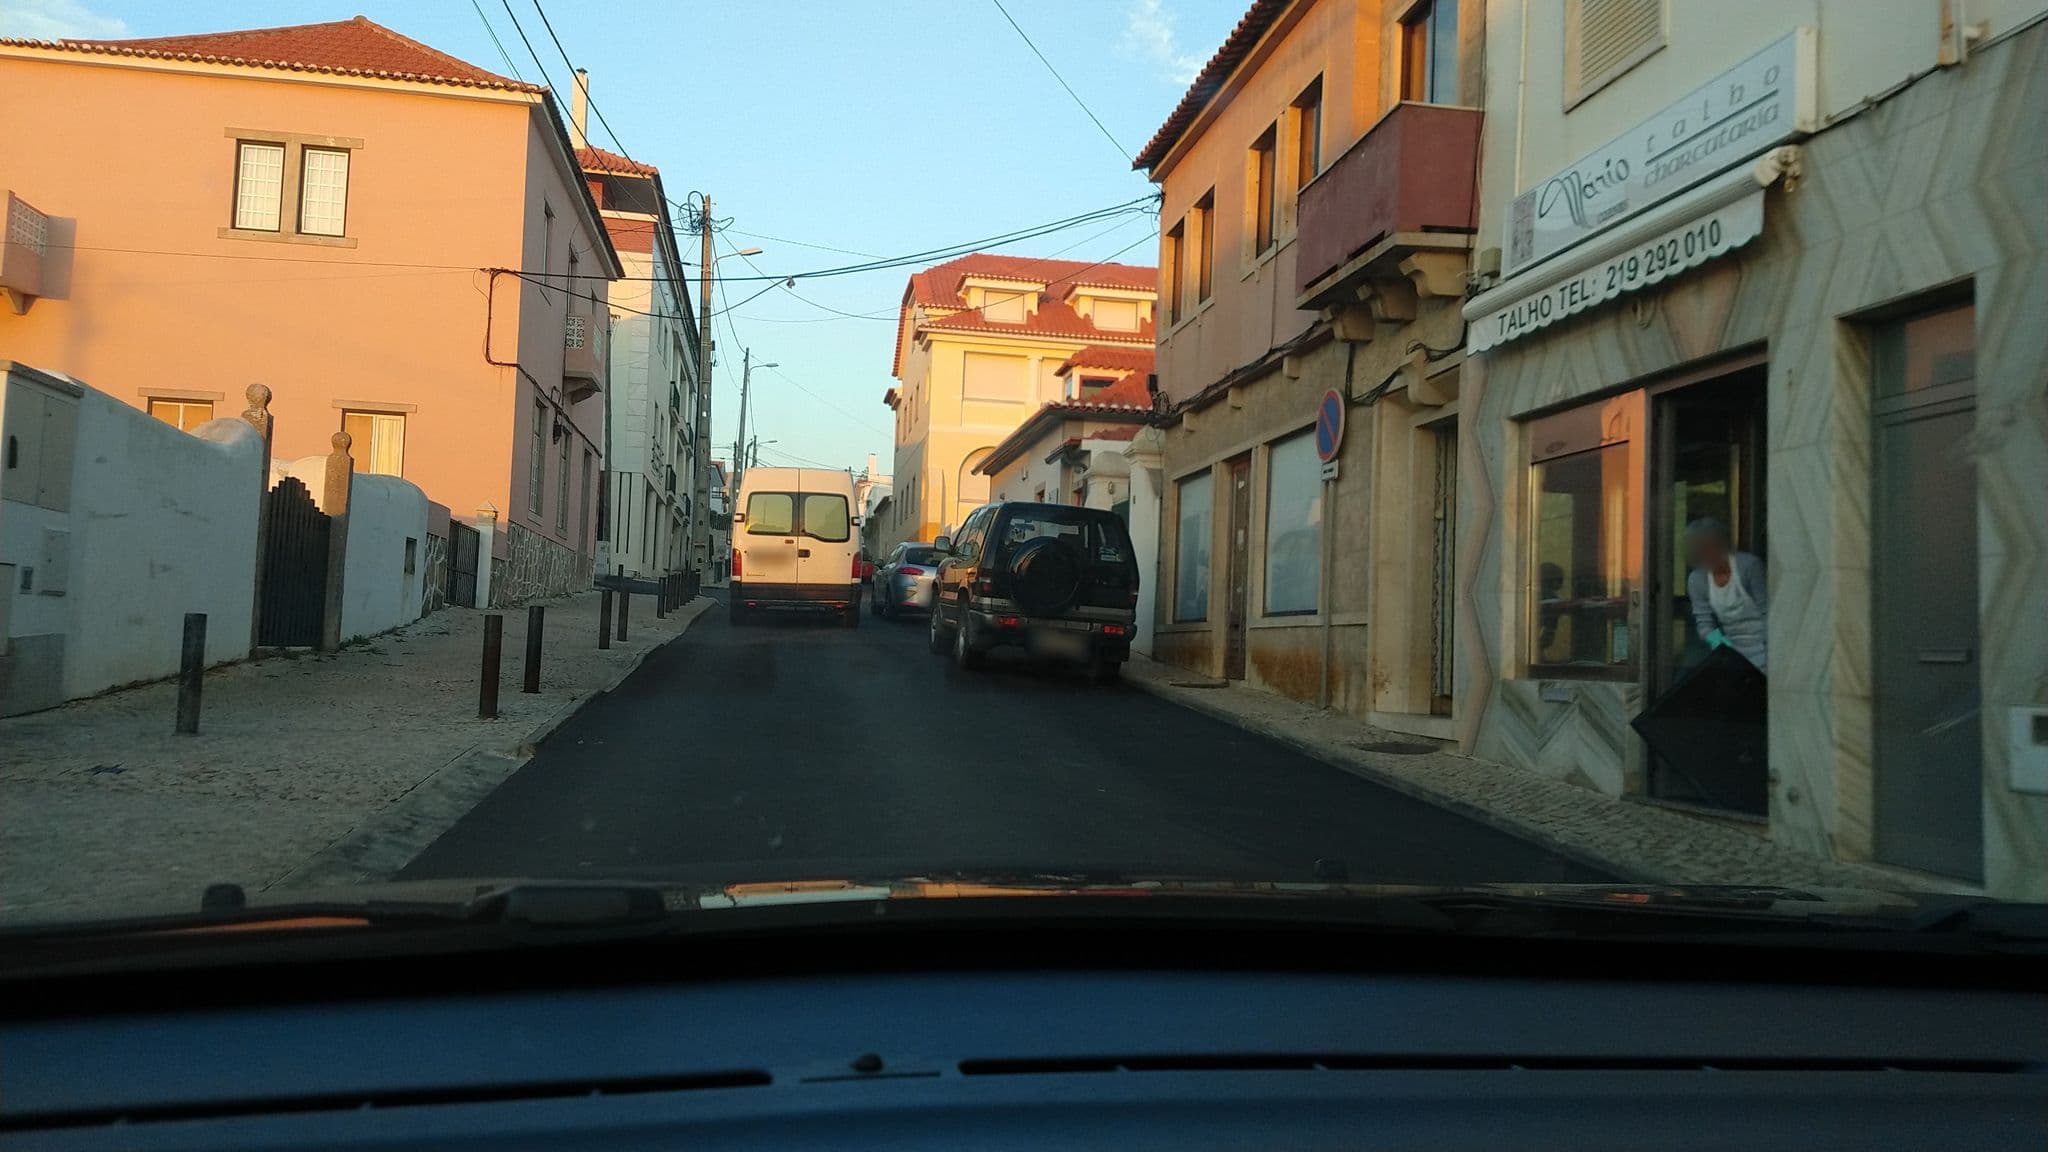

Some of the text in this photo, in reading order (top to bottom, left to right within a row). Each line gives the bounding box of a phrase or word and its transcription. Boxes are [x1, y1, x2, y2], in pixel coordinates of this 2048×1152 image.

[1498, 294, 1552, 336] TALHO
[1605, 255, 1639, 291] 219
[1644, 239, 1680, 276] 292
[1684, 218, 1721, 258] 010
